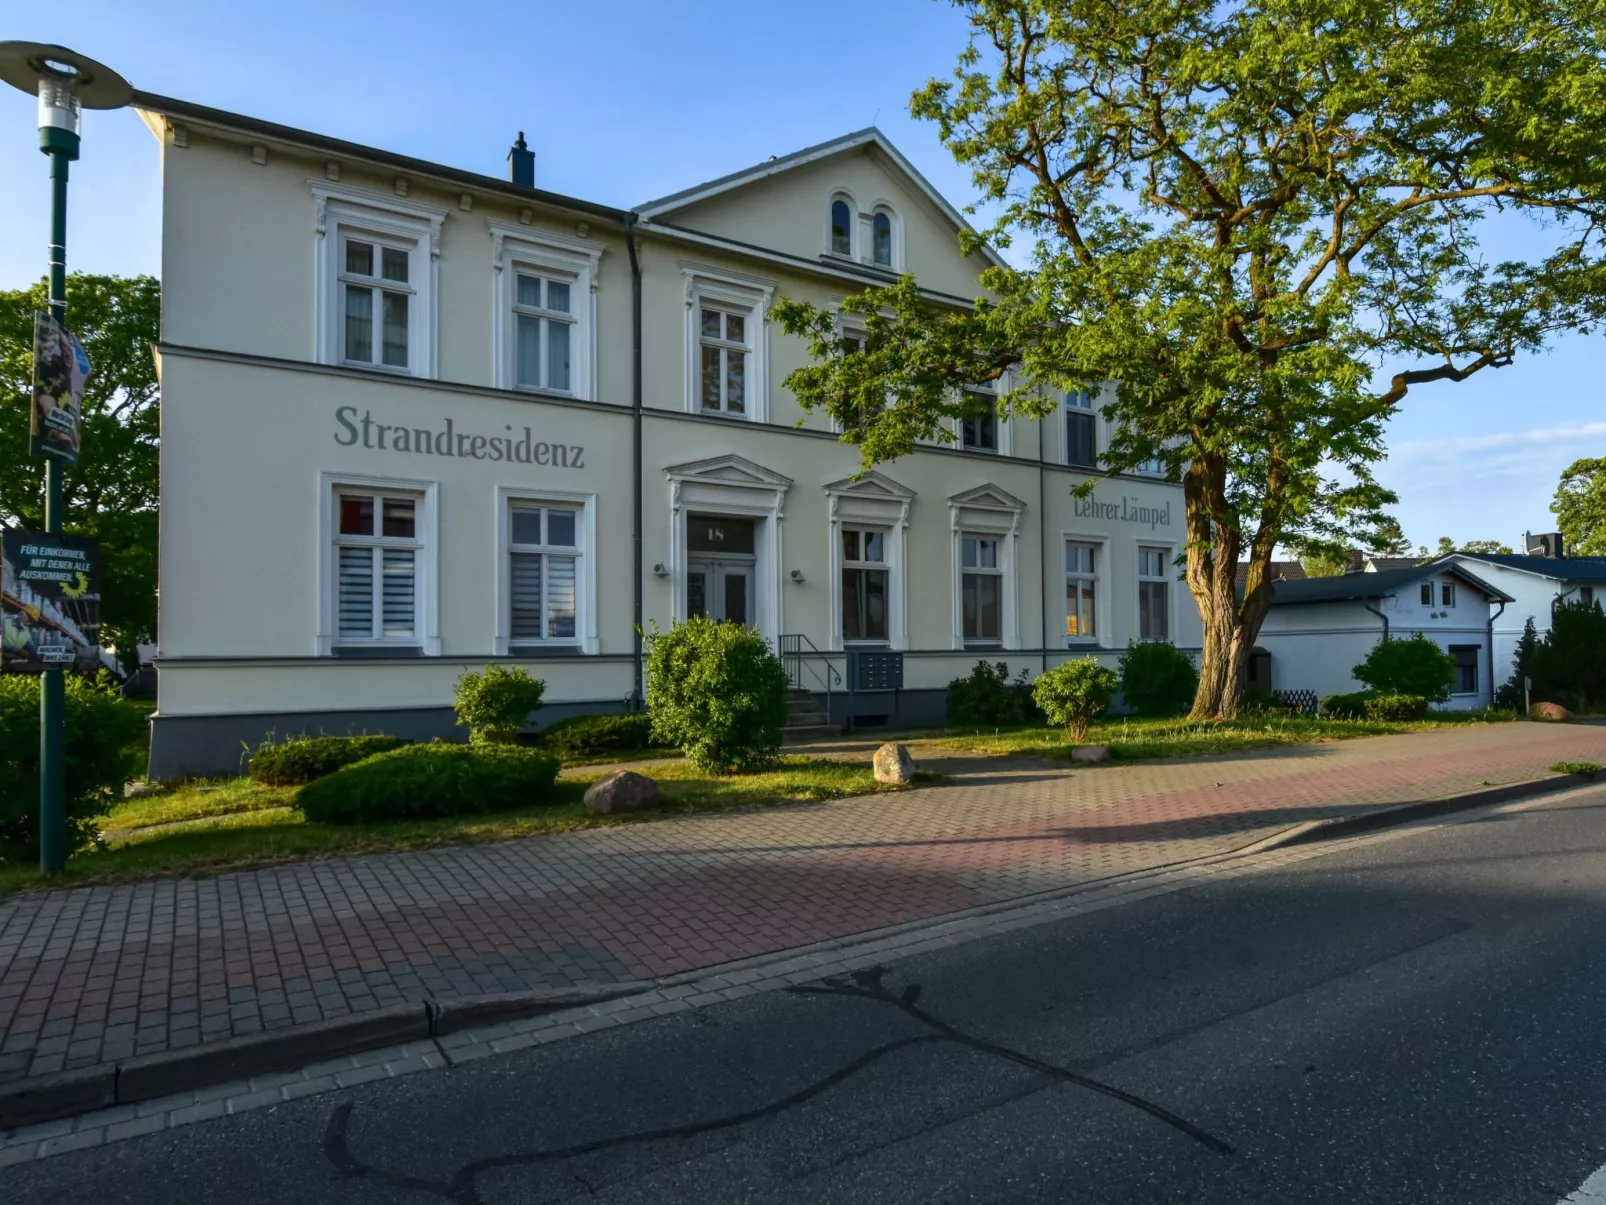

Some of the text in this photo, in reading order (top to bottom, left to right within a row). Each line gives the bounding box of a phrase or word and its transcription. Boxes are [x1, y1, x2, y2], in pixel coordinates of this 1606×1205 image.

[334, 405, 585, 469] Strandresidenz
[1074, 492, 1171, 531] Lehrer Lämpel
[708, 527, 724, 541] 18
[20, 544, 38, 556] FÜR
[30, 558, 91, 572] MIT DENEN ALLE
